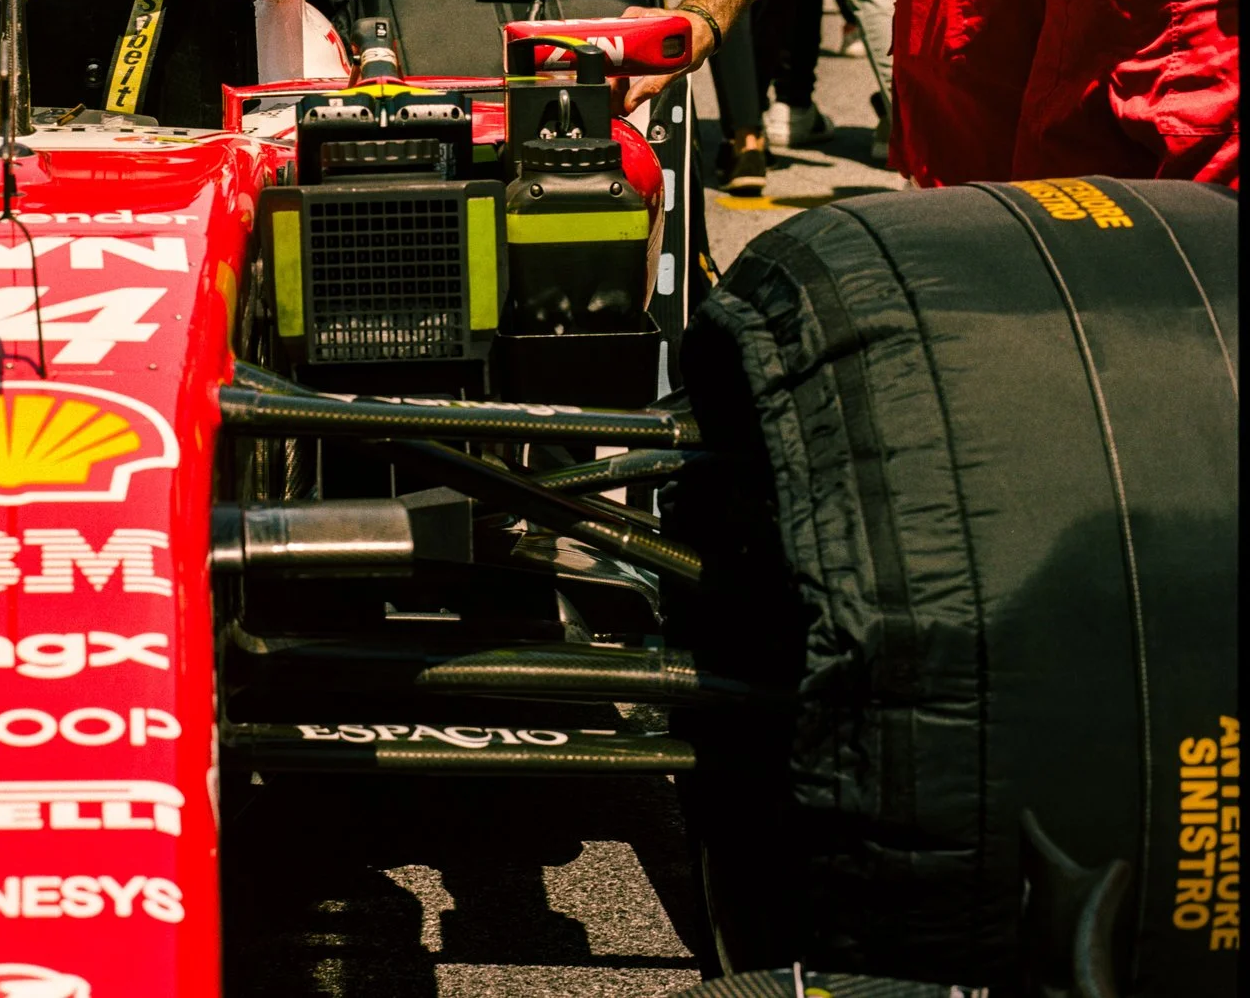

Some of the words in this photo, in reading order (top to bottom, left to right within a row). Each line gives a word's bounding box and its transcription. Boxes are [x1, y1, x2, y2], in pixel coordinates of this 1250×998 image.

[543, 36, 625, 68] ZN
[295, 724, 569, 750] ESPACIO
[1172, 736, 1219, 931] SINISTRO
